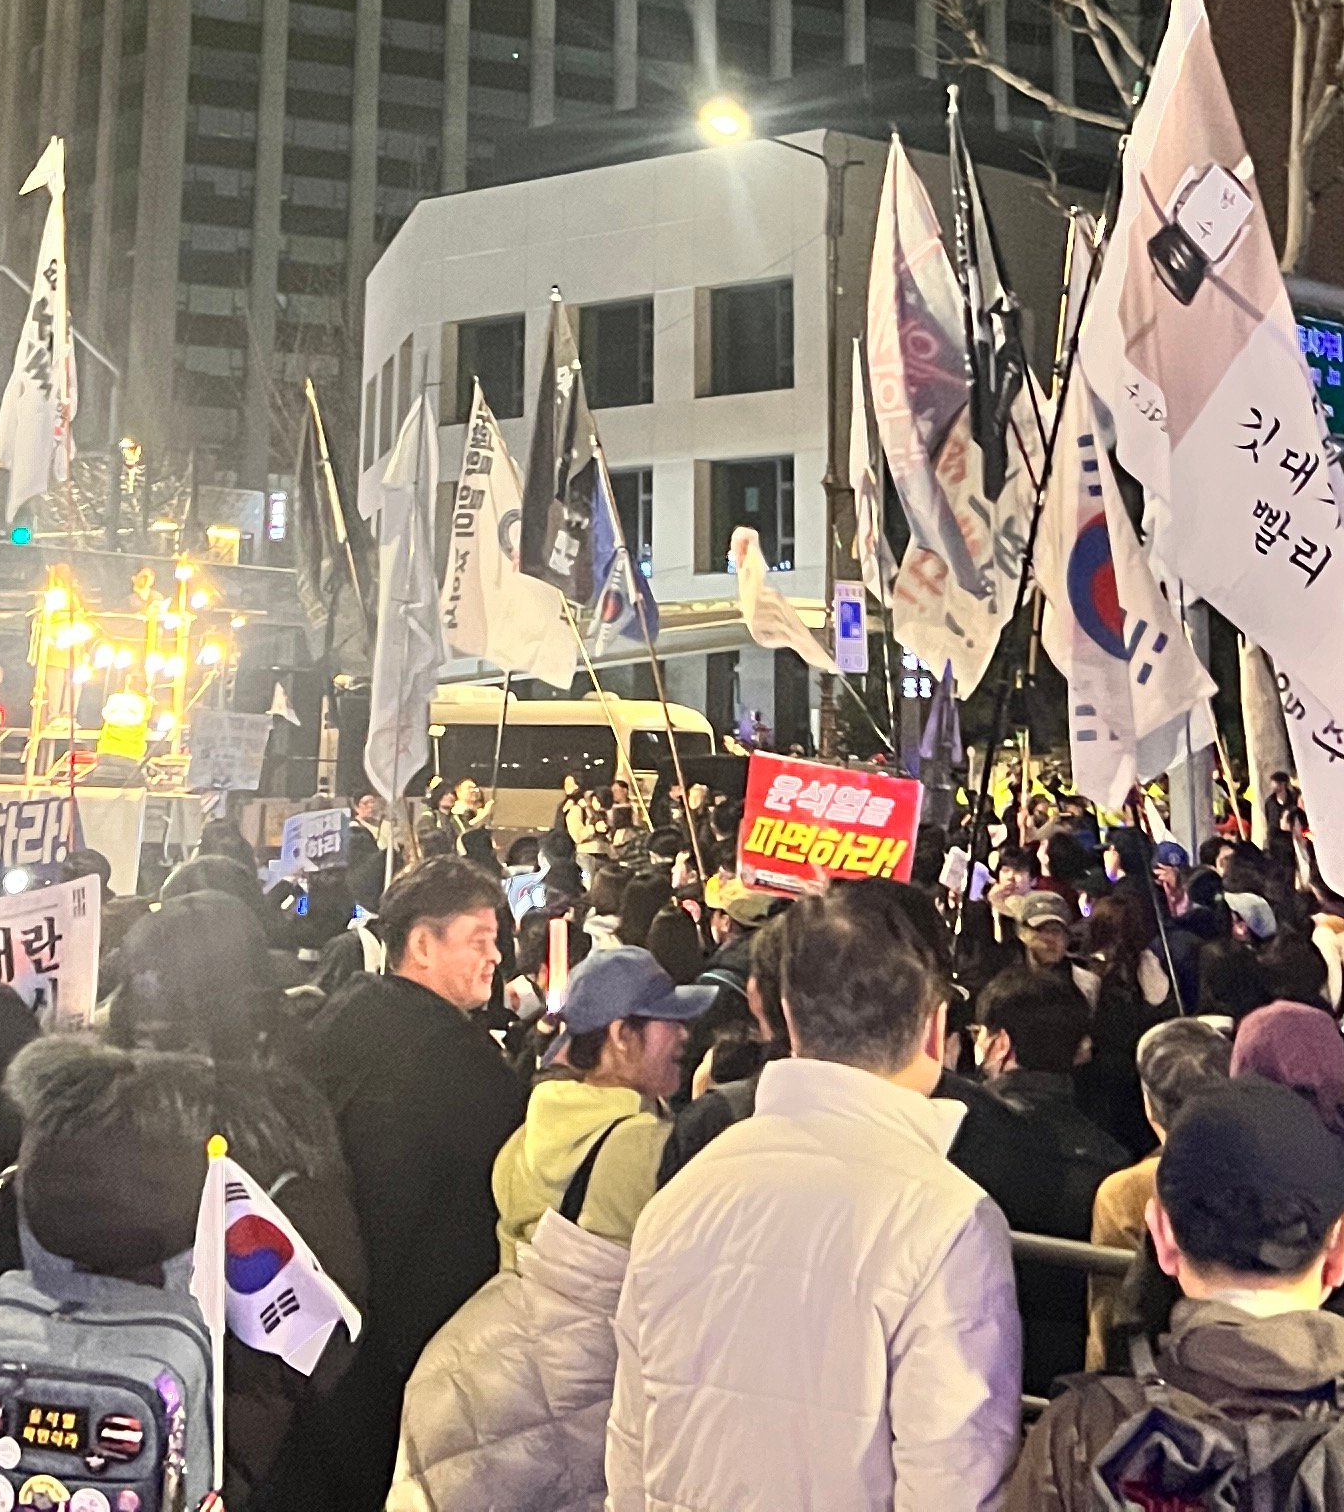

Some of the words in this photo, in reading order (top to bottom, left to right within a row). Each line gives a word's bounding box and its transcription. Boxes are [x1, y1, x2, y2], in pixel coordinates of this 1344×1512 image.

[1252, 497, 1333, 589] 빨리
[763, 774, 895, 828] 윤석열을
[743, 816, 909, 879] 파면하라!
